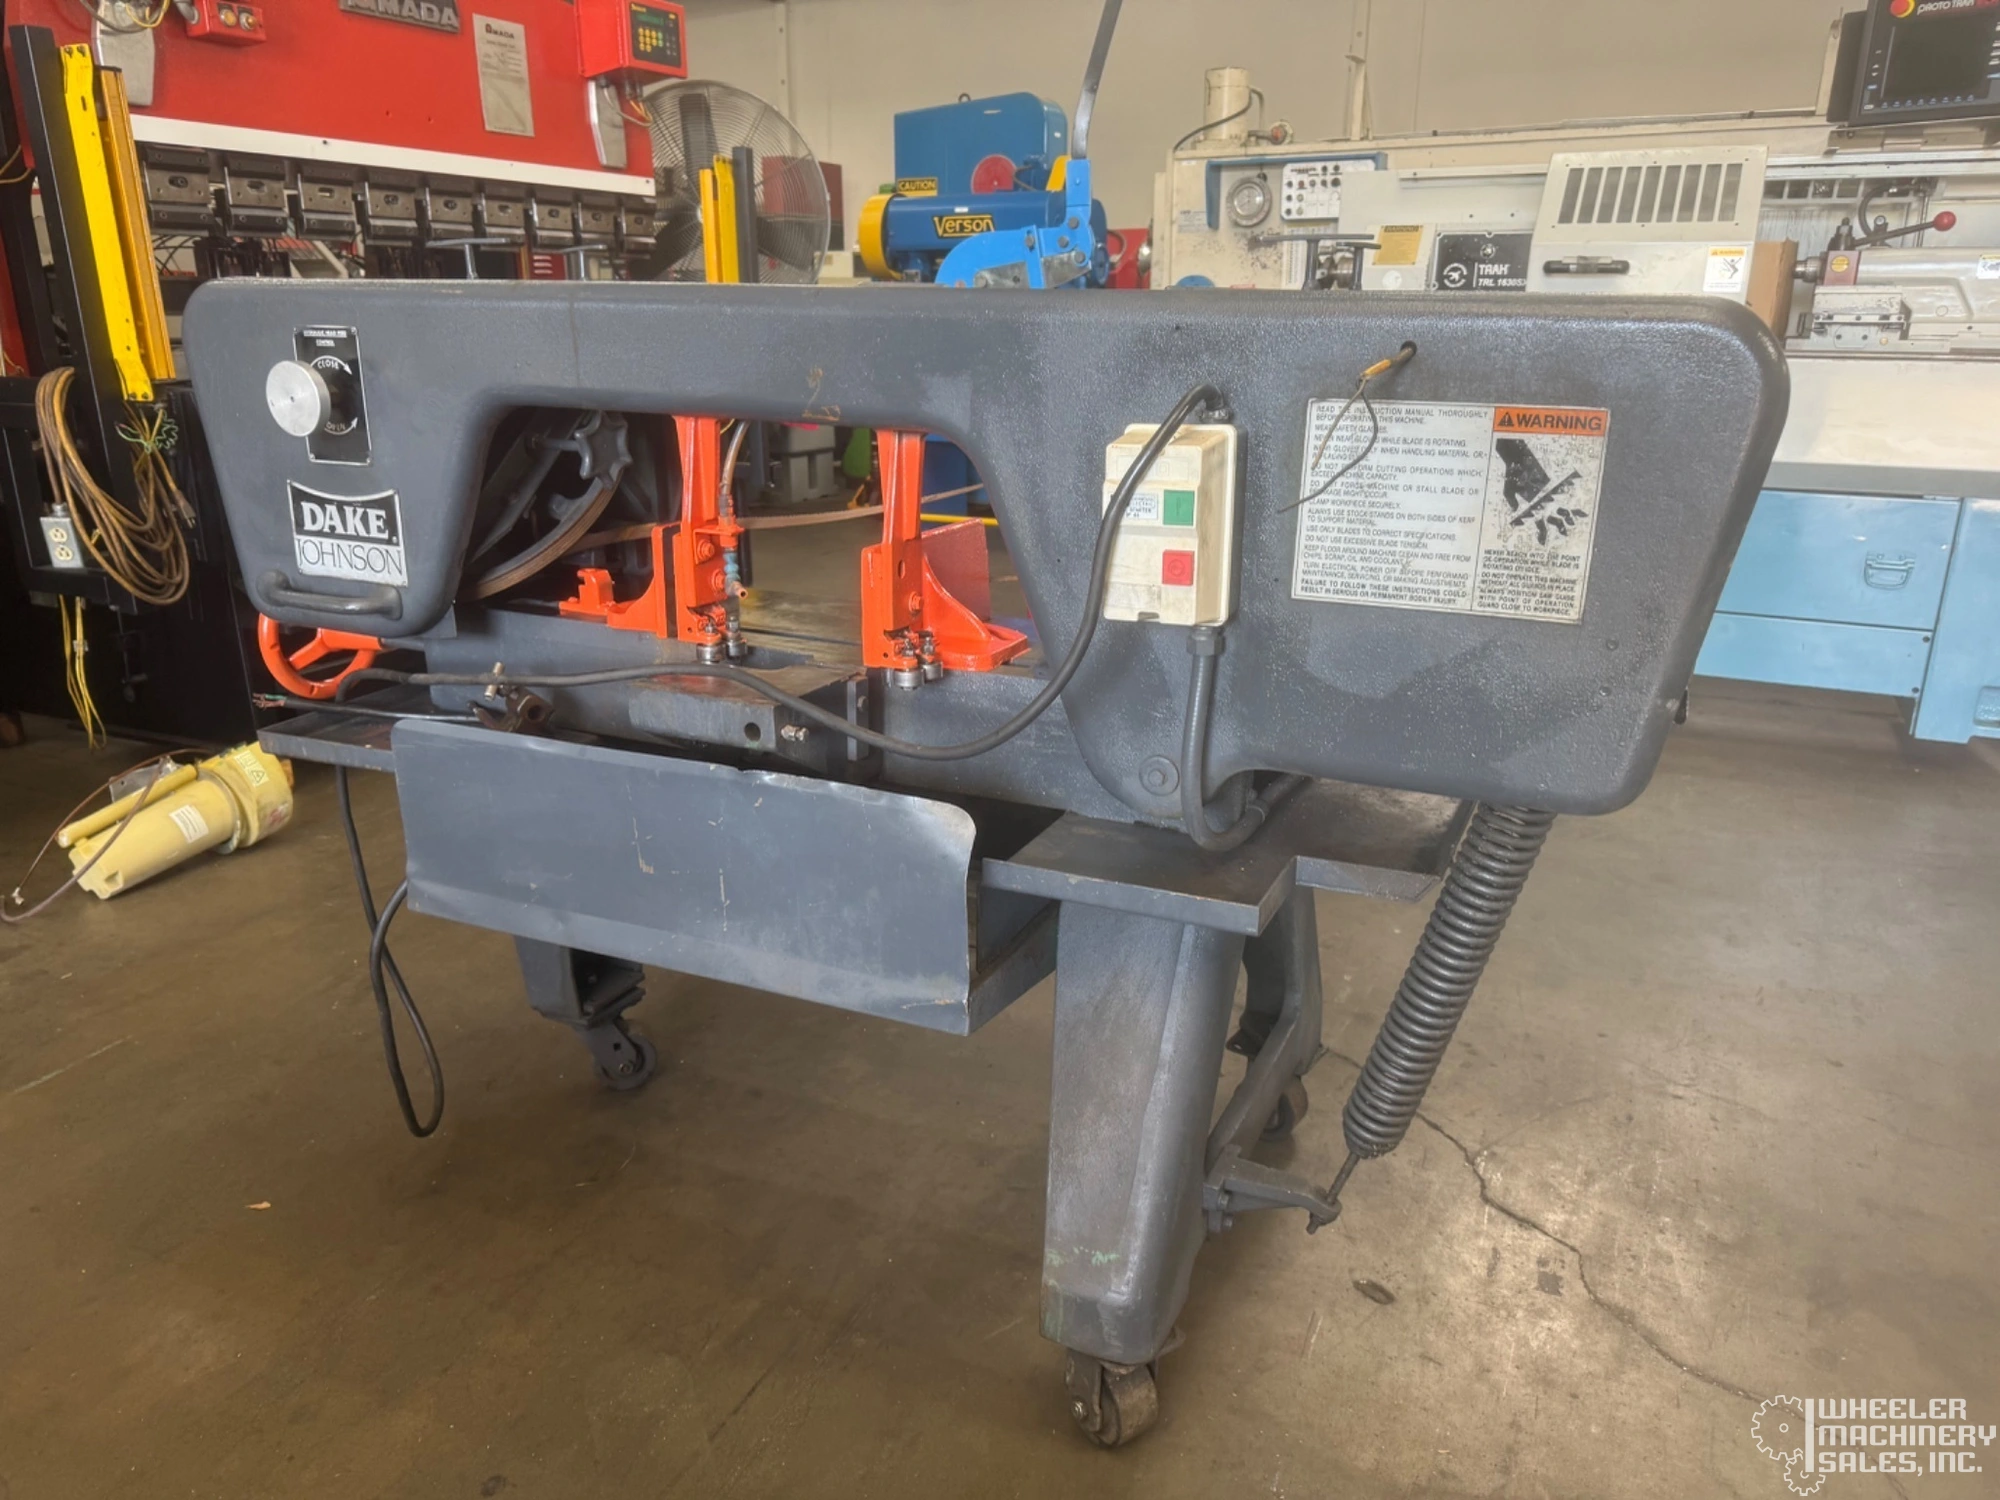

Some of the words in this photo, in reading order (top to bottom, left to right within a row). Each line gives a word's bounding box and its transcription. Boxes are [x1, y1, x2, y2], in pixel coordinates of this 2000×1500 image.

[900, 180, 936, 190] CAUTION
[934, 216, 995, 236] Verson
[317, 359, 339, 370] CLOSE
[1337, 406, 1350, 414] TE
[1354, 407, 1402, 415] INSTUCTION
[1438, 410, 1488, 418] THOROUGHLY
[1516, 413, 1602, 431] WARNING
[1381, 447, 1400, 455] WHEN
[1401, 448, 1435, 456] HANDLING
[1438, 450, 1470, 458] MATERIAL
[1410, 467, 1454, 475] OPERATIONS
[1416, 485, 1438, 493] STALL
[301, 501, 389, 539] DAKE
[1317, 516, 1345, 524] SUPPORT
[1337, 527, 1360, 535] BLADES
[1372, 529, 1402, 538] CORRECT
[1343, 538, 1376, 546] EXCESSIVE
[295, 538, 403, 576] JOHNSON
[1452, 554, 1471, 562] FROM
[1360, 566, 1383, 574] POWER
[1301, 579, 1327, 587] FAILURE
[1340, 582, 1366, 590] FOLLOW
[1369, 584, 1390, 592] THESE
[1392, 585, 1440, 596] INSTRUCTIONS
[1443, 589, 1467, 598] COULD
[1301, 586, 1324, 594] RESULT
[1332, 589, 1359, 597] SERIOUS
[1370, 591, 1408, 601] PERMANENT
